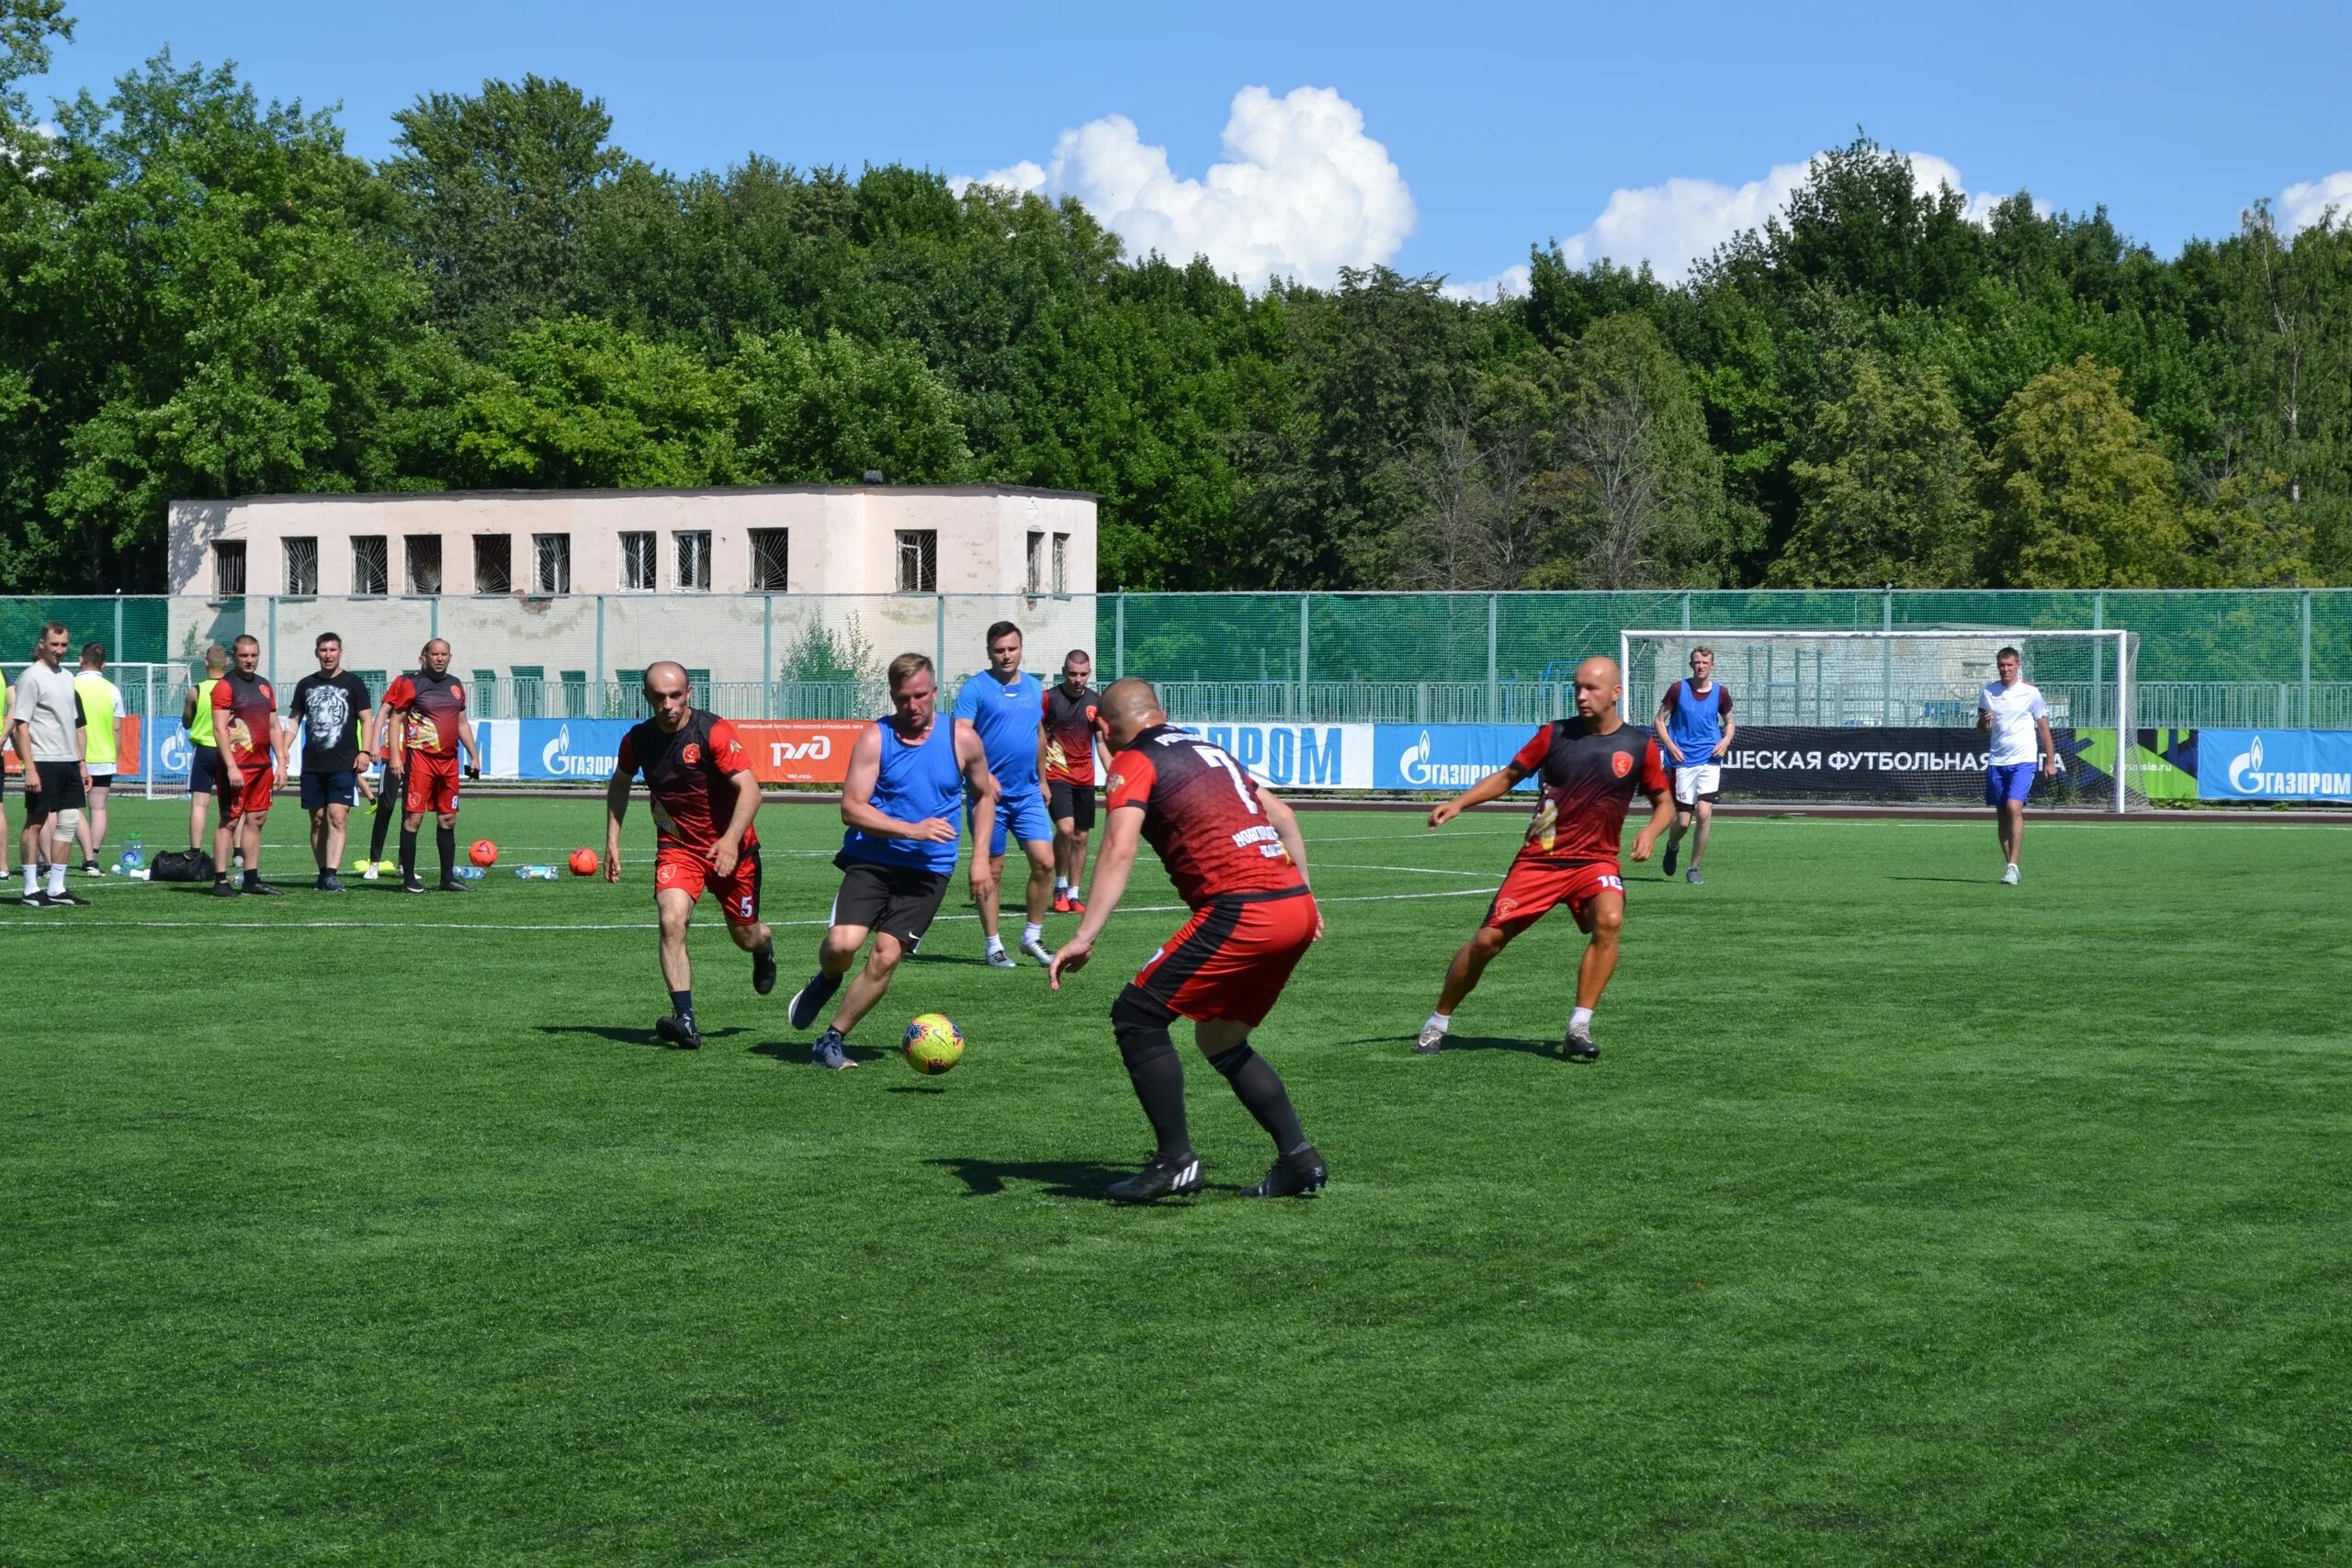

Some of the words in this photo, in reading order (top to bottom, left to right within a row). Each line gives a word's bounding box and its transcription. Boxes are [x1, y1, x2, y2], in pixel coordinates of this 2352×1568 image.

[571, 756, 618, 775] ГАЗПР
[1721, 750, 1822, 770] ШЕСКАЯ
[1828, 751, 1990, 771] ФУТБОЛЬНАЯ
[2038, 752, 2066, 772] ГА
[1192, 745, 1259, 815] 7
[2265, 773, 2351, 794] ГАЗПРОМ
[740, 896, 752, 918] 5
